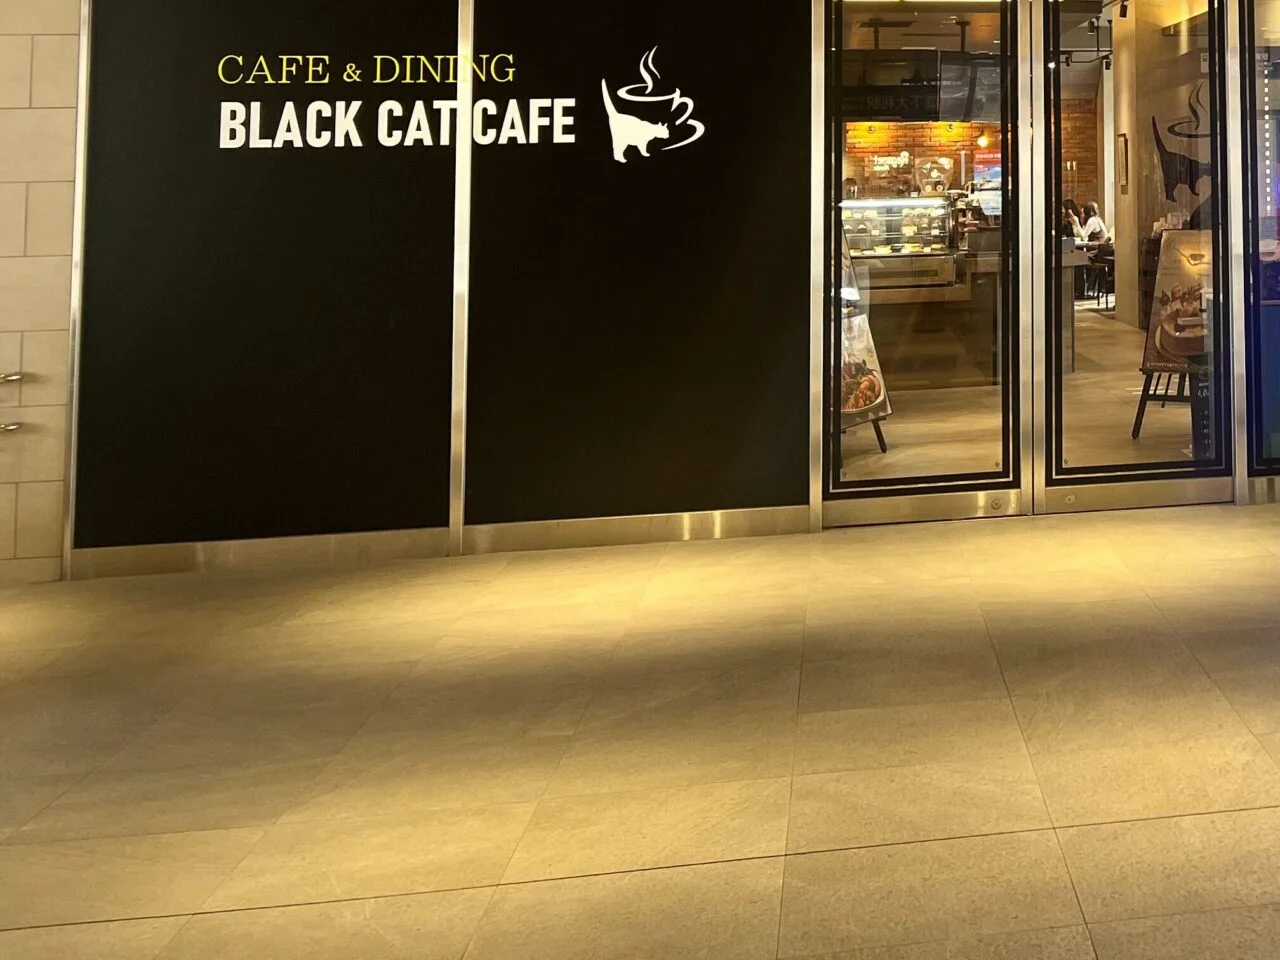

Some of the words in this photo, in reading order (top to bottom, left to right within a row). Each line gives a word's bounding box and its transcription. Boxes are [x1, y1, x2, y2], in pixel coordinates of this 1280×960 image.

[218, 55, 330, 84] CAFE
[342, 63, 363, 82] &
[373, 53, 517, 83] DINING
[219, 100, 363, 148] BLACK
[377, 100, 459, 146] CAT
[472, 98, 576, 144] CAFE
